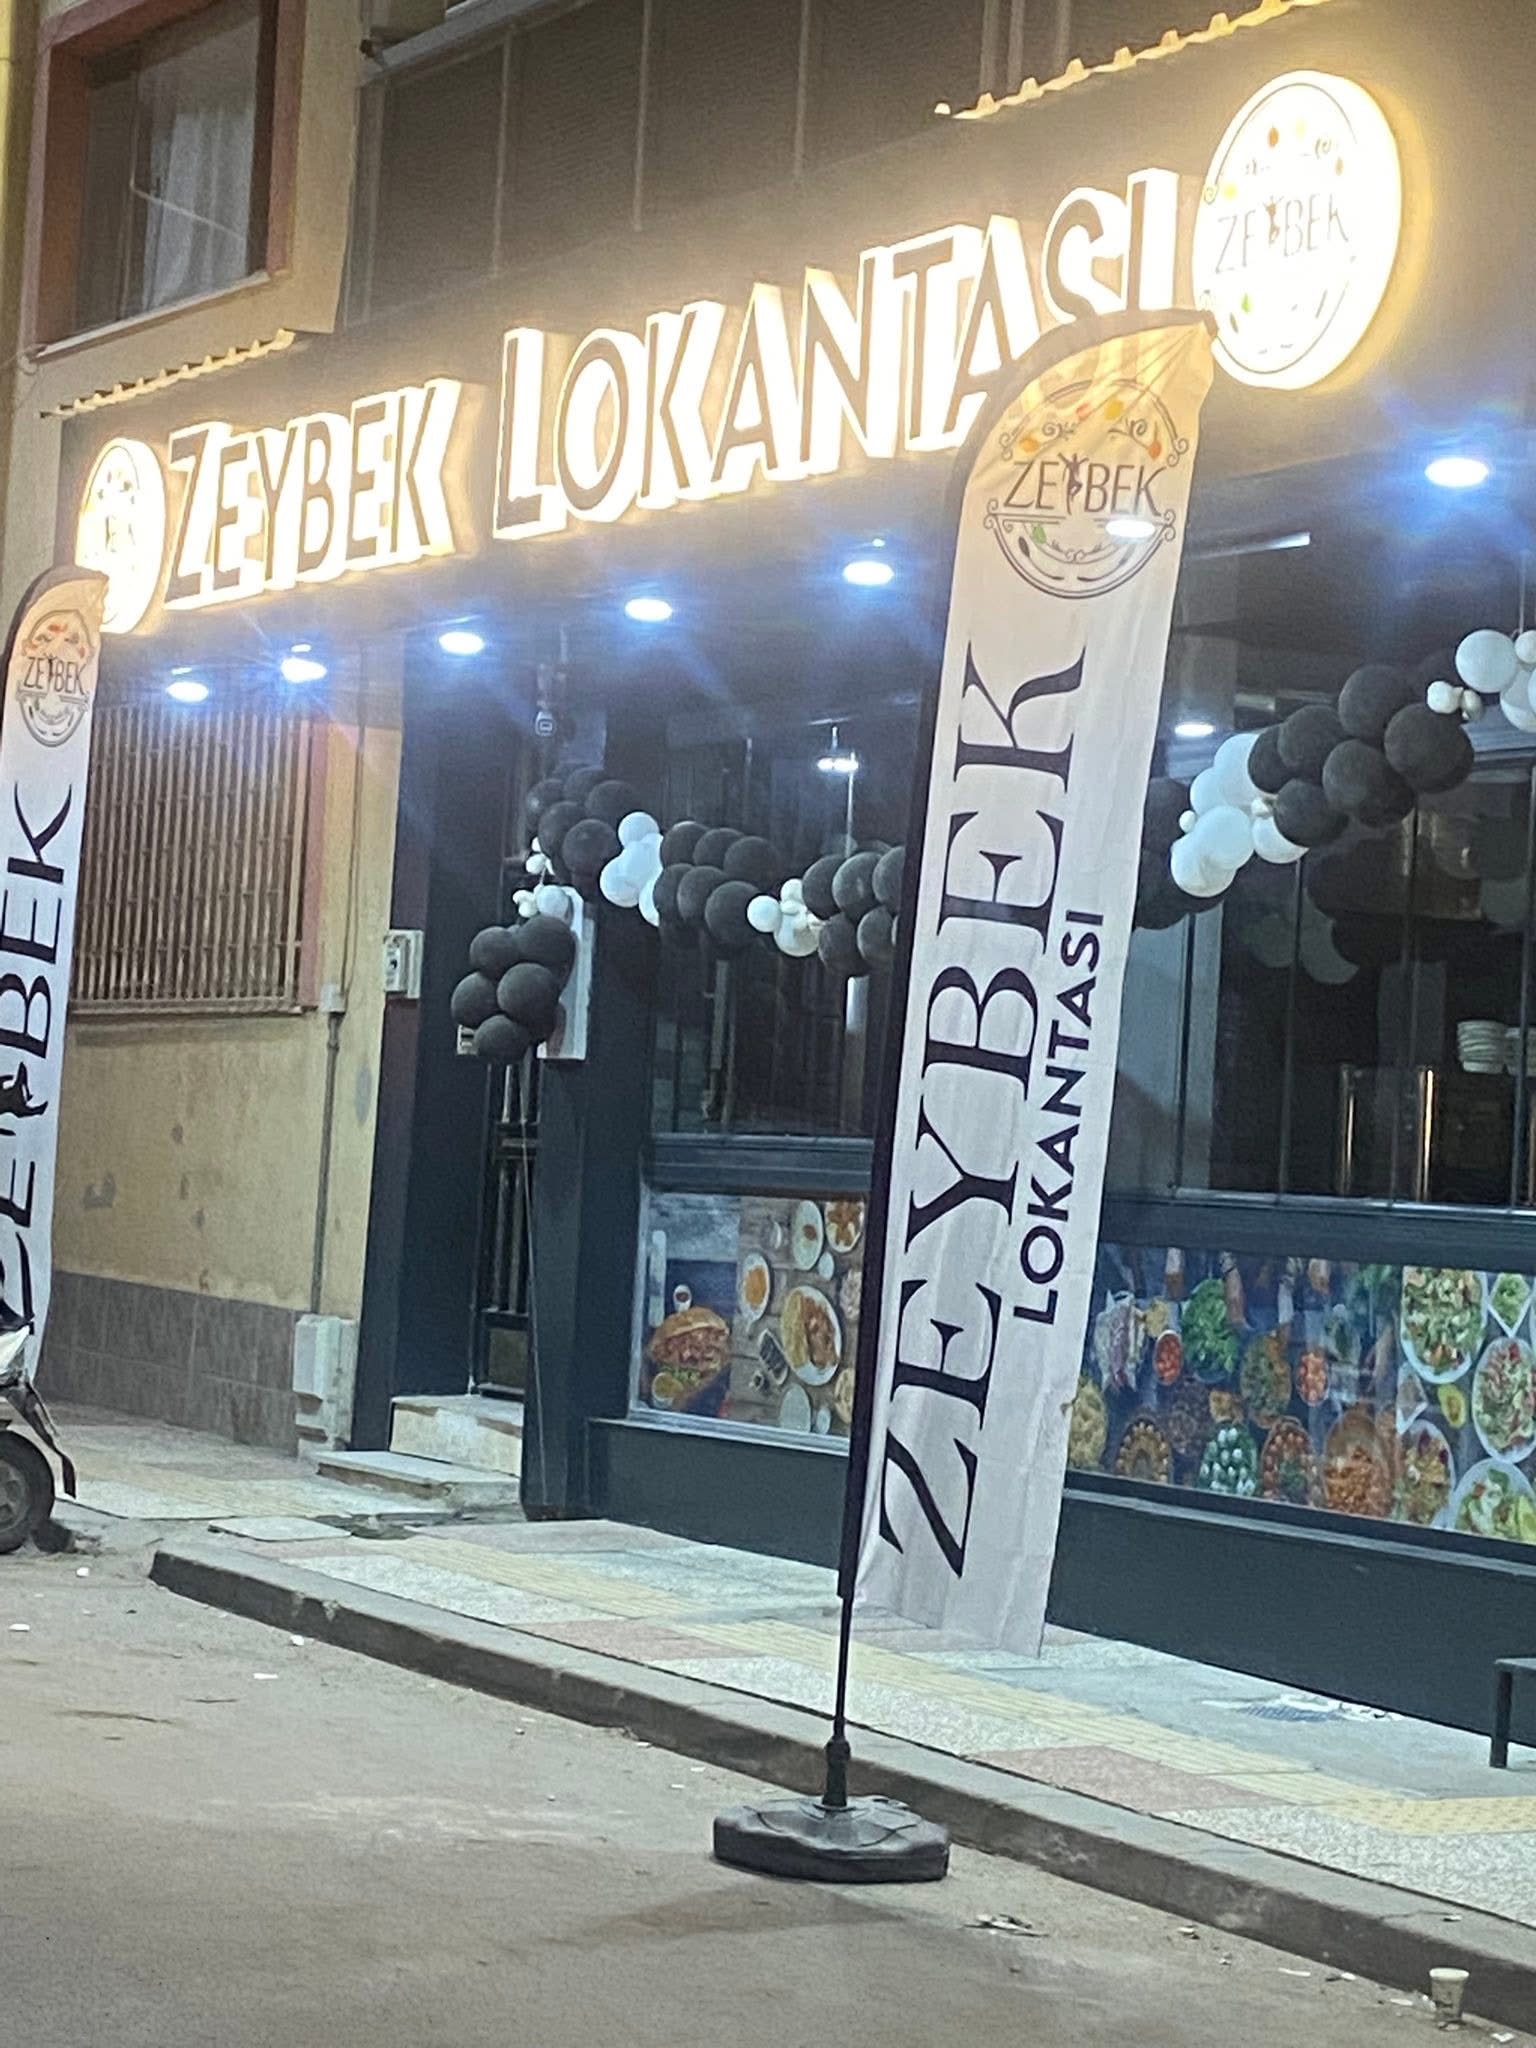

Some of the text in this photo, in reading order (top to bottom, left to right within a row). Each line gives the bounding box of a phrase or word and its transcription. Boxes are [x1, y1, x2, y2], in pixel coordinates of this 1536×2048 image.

[164, 168, 1180, 610] ZEYBEK LOKANTASI
[1003, 453, 1168, 516] ZEYBEK
[877, 639, 1087, 1579] ZEYBEK
[1013, 909, 1103, 1325] LOKANTASI
